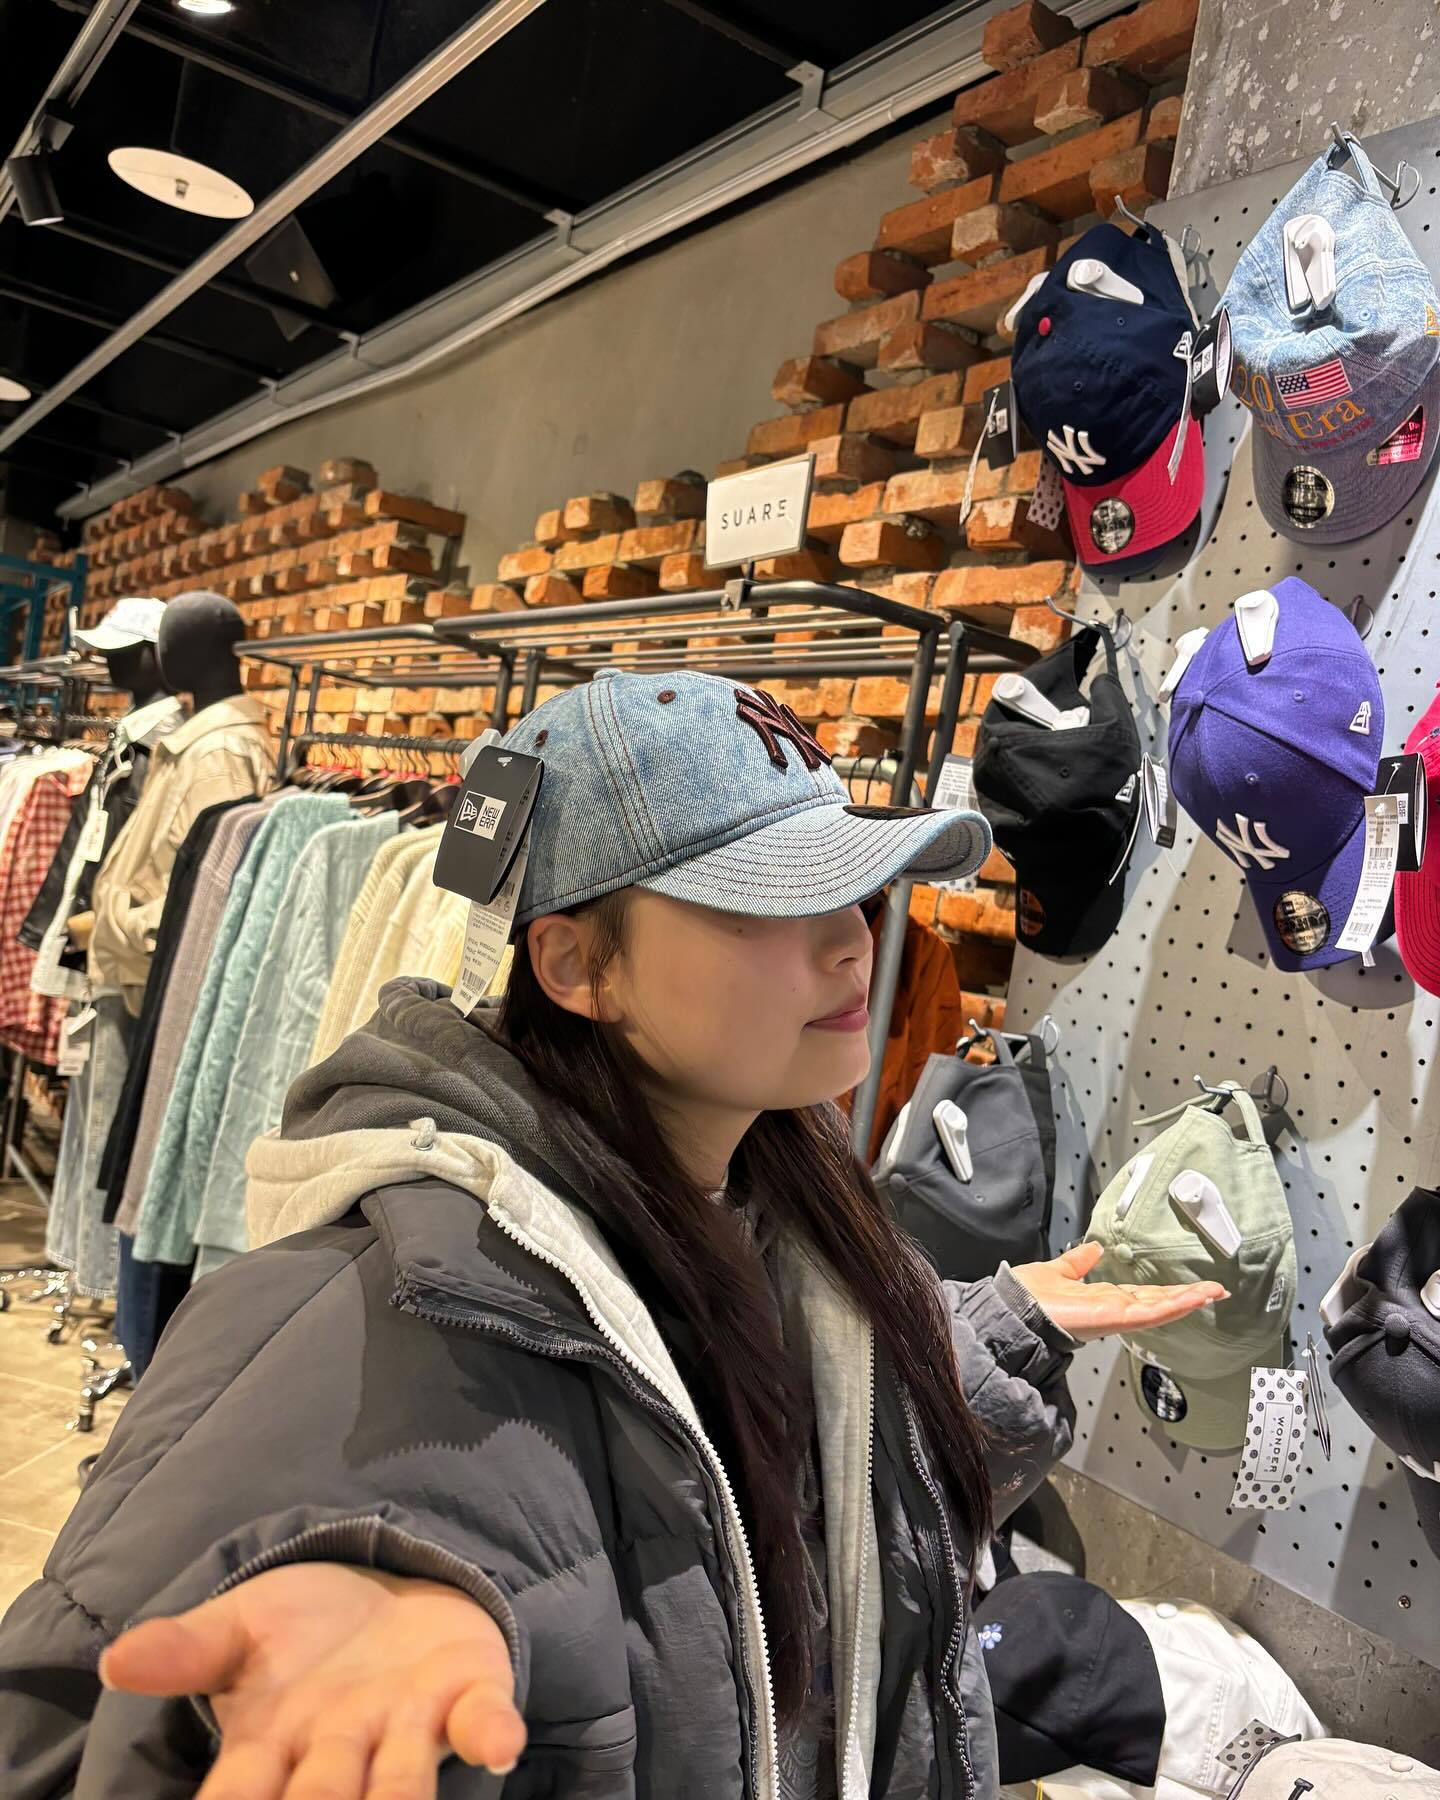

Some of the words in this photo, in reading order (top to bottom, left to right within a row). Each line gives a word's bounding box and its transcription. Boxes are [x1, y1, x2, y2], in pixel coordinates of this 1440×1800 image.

[1285, 399, 1366, 439] Era
[1046, 424, 1107, 476] NY
[721, 499, 787, 530] SUARE
[478, 816, 496, 831] ERA
[482, 805, 501, 819] NEW
[1216, 812, 1290, 870] NY
[1269, 1416, 1285, 1473] WONDER
